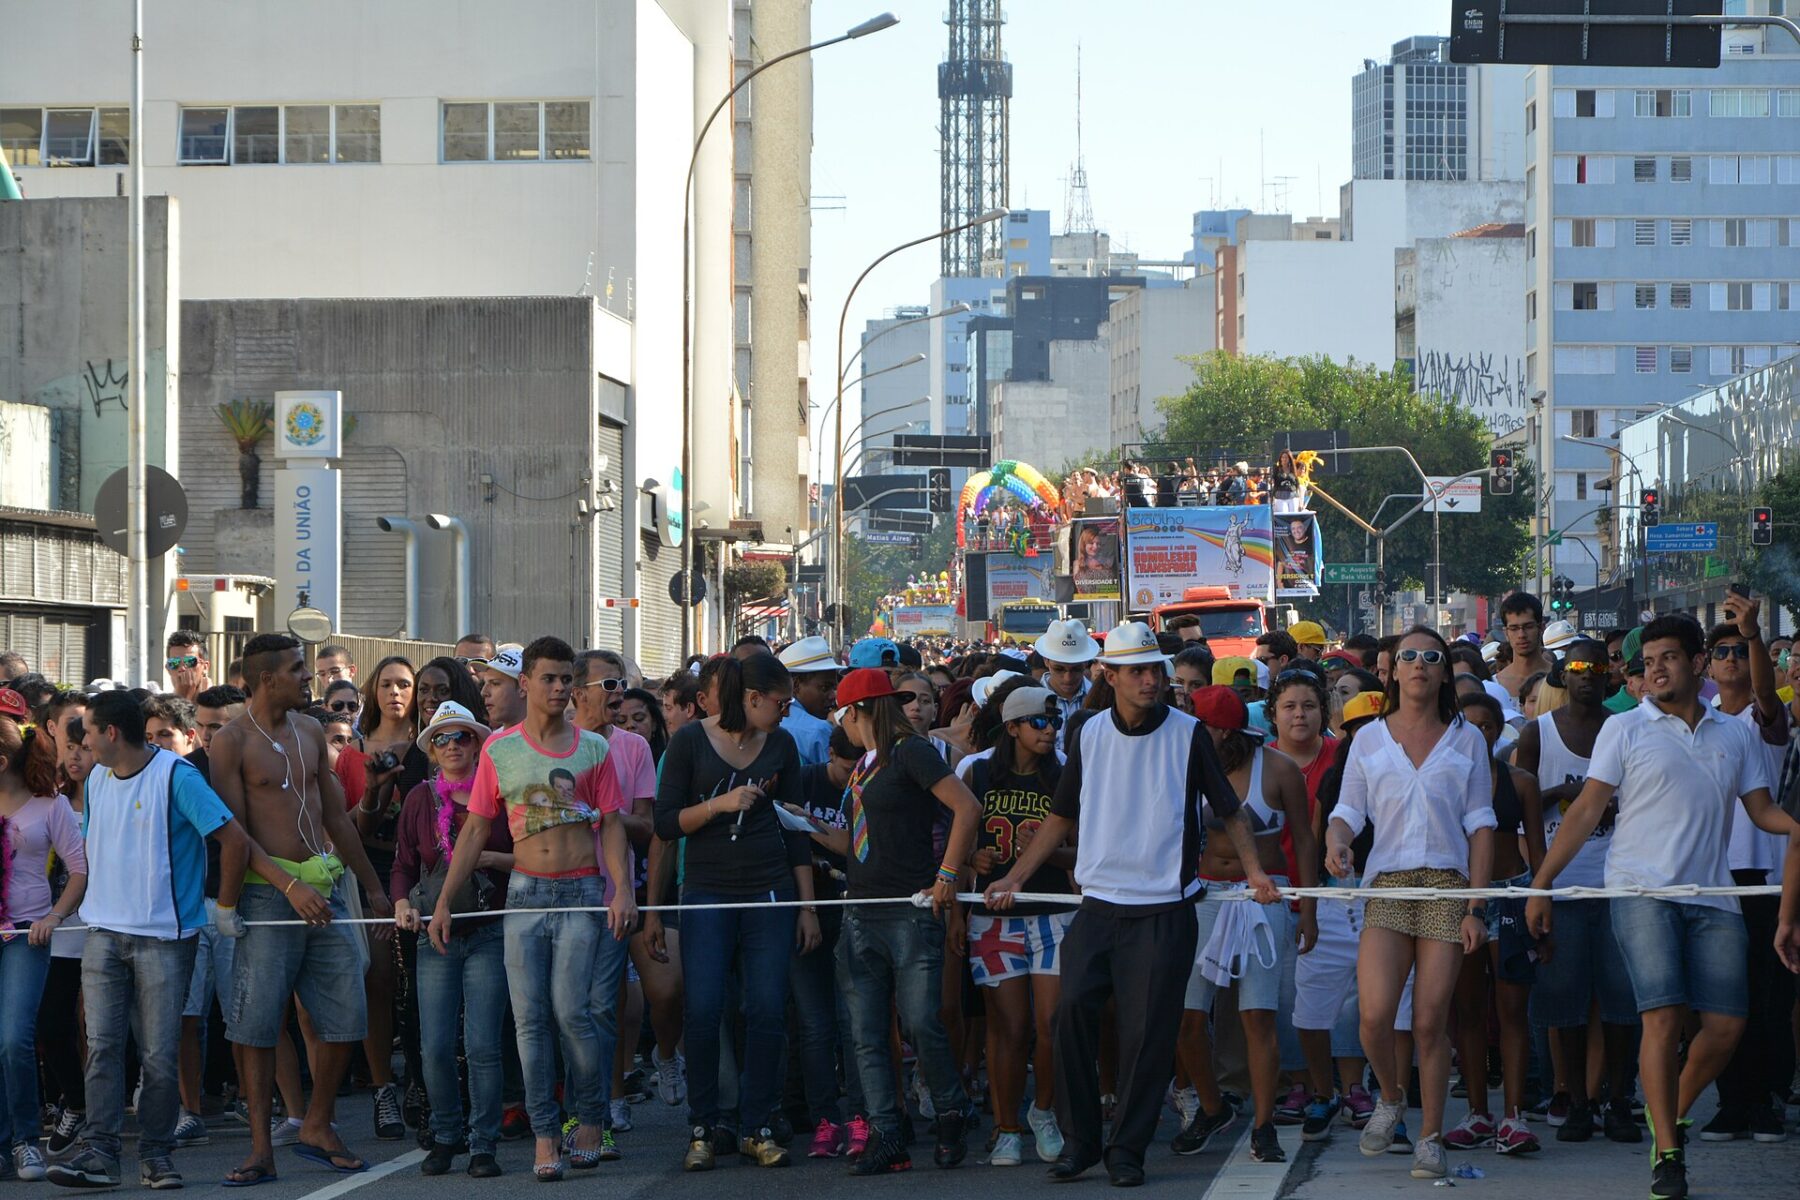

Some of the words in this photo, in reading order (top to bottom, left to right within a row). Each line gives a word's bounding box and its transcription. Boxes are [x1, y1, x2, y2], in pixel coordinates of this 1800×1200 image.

[293, 485, 311, 540] UNIÃO
[296, 548, 311, 572] DA
[983, 789, 1053, 819] BULLS
